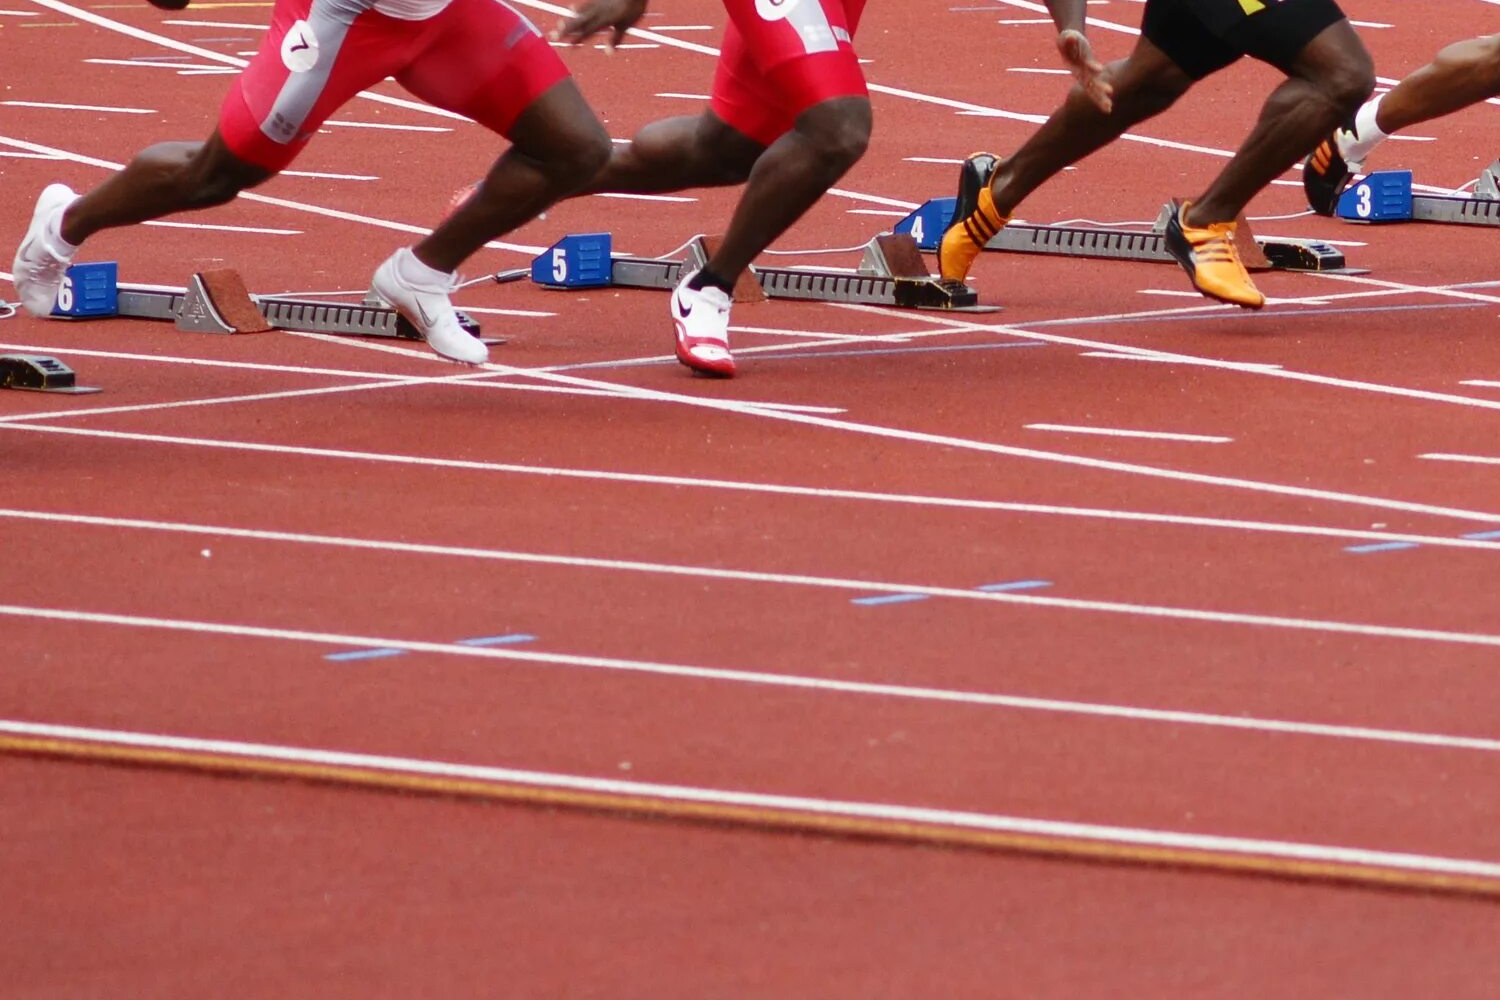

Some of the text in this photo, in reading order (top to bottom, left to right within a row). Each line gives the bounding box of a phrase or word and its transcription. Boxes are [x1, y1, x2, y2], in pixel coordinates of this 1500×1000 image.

[290, 31, 309, 53] 7
[1356, 184, 1371, 218] 3
[910, 216, 924, 243] 4
[552, 248, 567, 282] 5
[58, 276, 73, 311] 6
